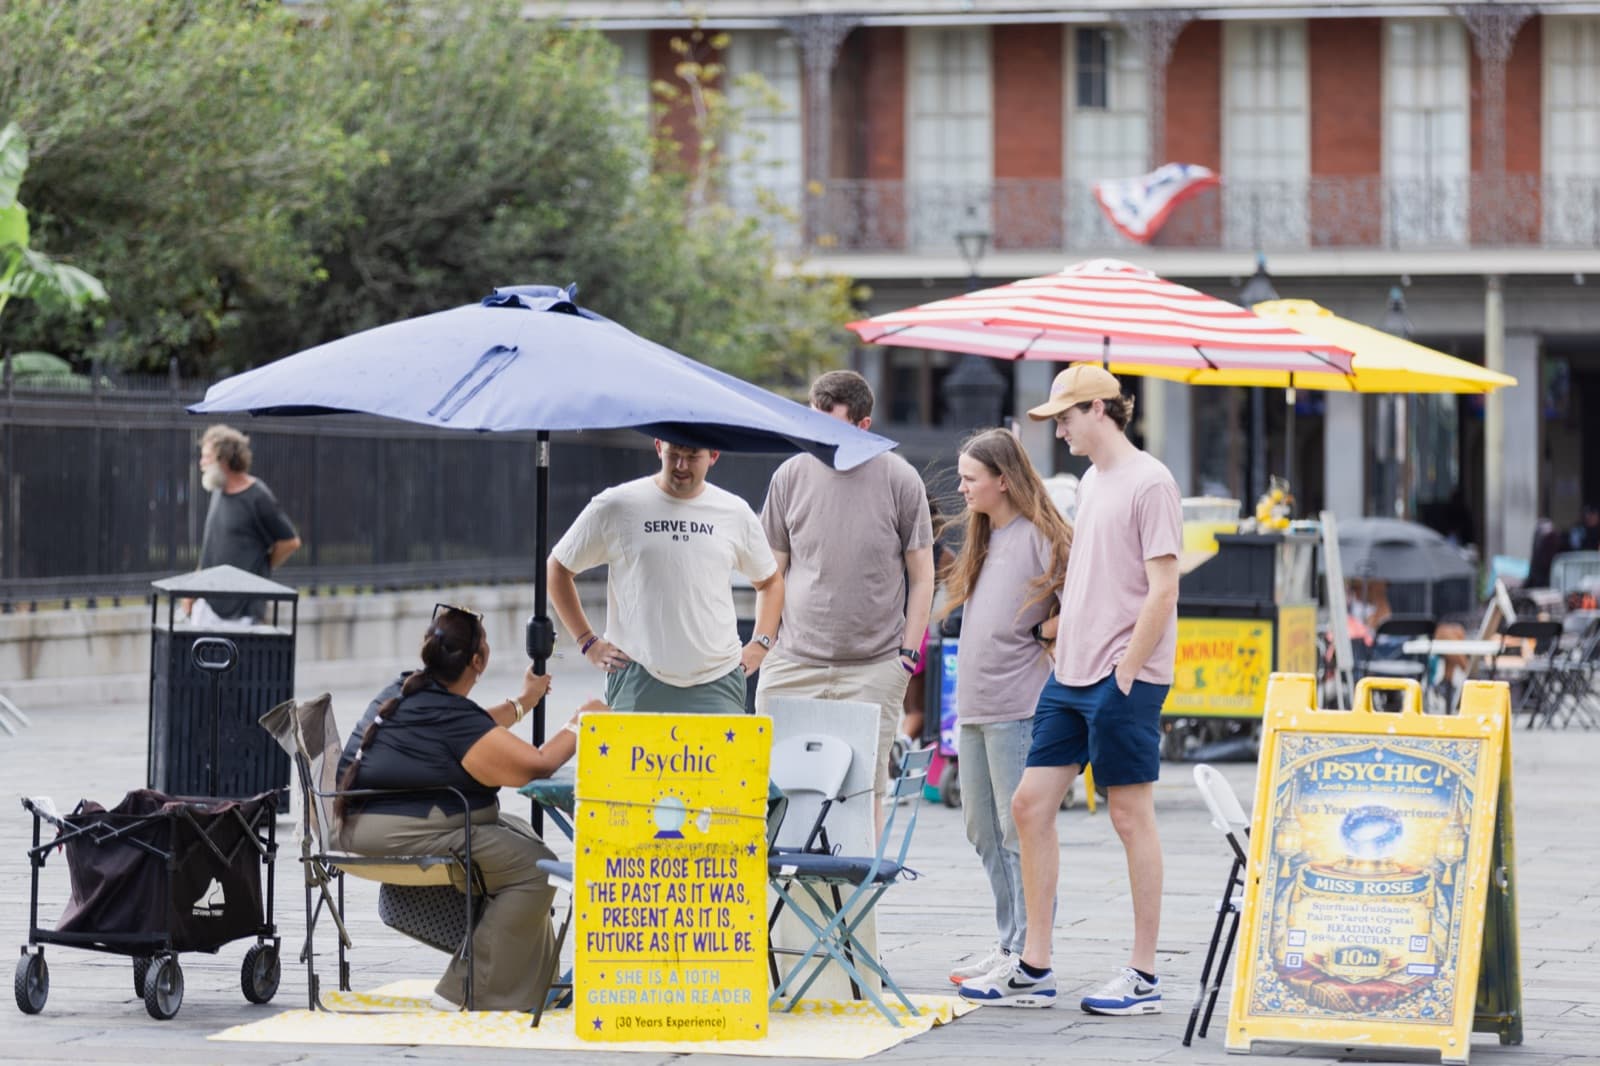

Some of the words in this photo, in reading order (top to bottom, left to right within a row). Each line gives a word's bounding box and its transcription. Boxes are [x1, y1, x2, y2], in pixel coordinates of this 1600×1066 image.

[644, 520, 687, 533] SERVE
[690, 521, 714, 535] DAY
[630, 744, 717, 781] Psychic
[1322, 761, 1434, 784] PSYCHIC
[1318, 782, 1344, 792] Look
[1347, 783, 1368, 792] Into
[1371, 784, 1393, 793] Your
[1397, 785, 1433, 794] Future
[1324, 804, 1363, 815] Years
[605, 858, 645, 878] MISS
[650, 858, 689, 878] ROSE
[694, 858, 737, 878] TELLS
[1314, 877, 1355, 892] MISS
[1363, 880, 1414, 894] ROSE
[587, 882, 616, 903] THE
[622, 882, 661, 903] PAST
[666, 882, 686, 903] AS
[691, 882, 705, 903] IT
[710, 882, 750, 905] WAS,
[1312, 902, 1359, 912] Spiritual
[1362, 904, 1410, 914] Guidance
[602, 907, 668, 928] PRESENT
[674, 907, 694, 928] AS
[700, 907, 712, 928] IT
[717, 907, 735, 930] IS,
[1307, 913, 1333, 921] Palm
[1340, 914, 1368, 922] Tarot
[1375, 915, 1414, 925] Crystal
[1327, 924, 1391, 935] READINGS
[587, 932, 644, 952] FUTURE
[650, 932, 669, 952] AS
[675, 932, 688, 952] IT
[693, 932, 729, 952] WILL
[734, 932, 755, 952] BE.
[1339, 934, 1405, 945] ACCURATE
[1340, 949, 1377, 966] 10th
[615, 970, 643, 985] SHE
[649, 970, 662, 985] IS
[669, 970, 679, 985] A
[686, 970, 720, 985] 10TH
[587, 989, 686, 1004] GENERATION
[691, 989, 752, 1004] READER
[615, 1016, 632, 1029] (30
[635, 1016, 663, 1028] Years
[666, 1016, 726, 1029] Experience)
